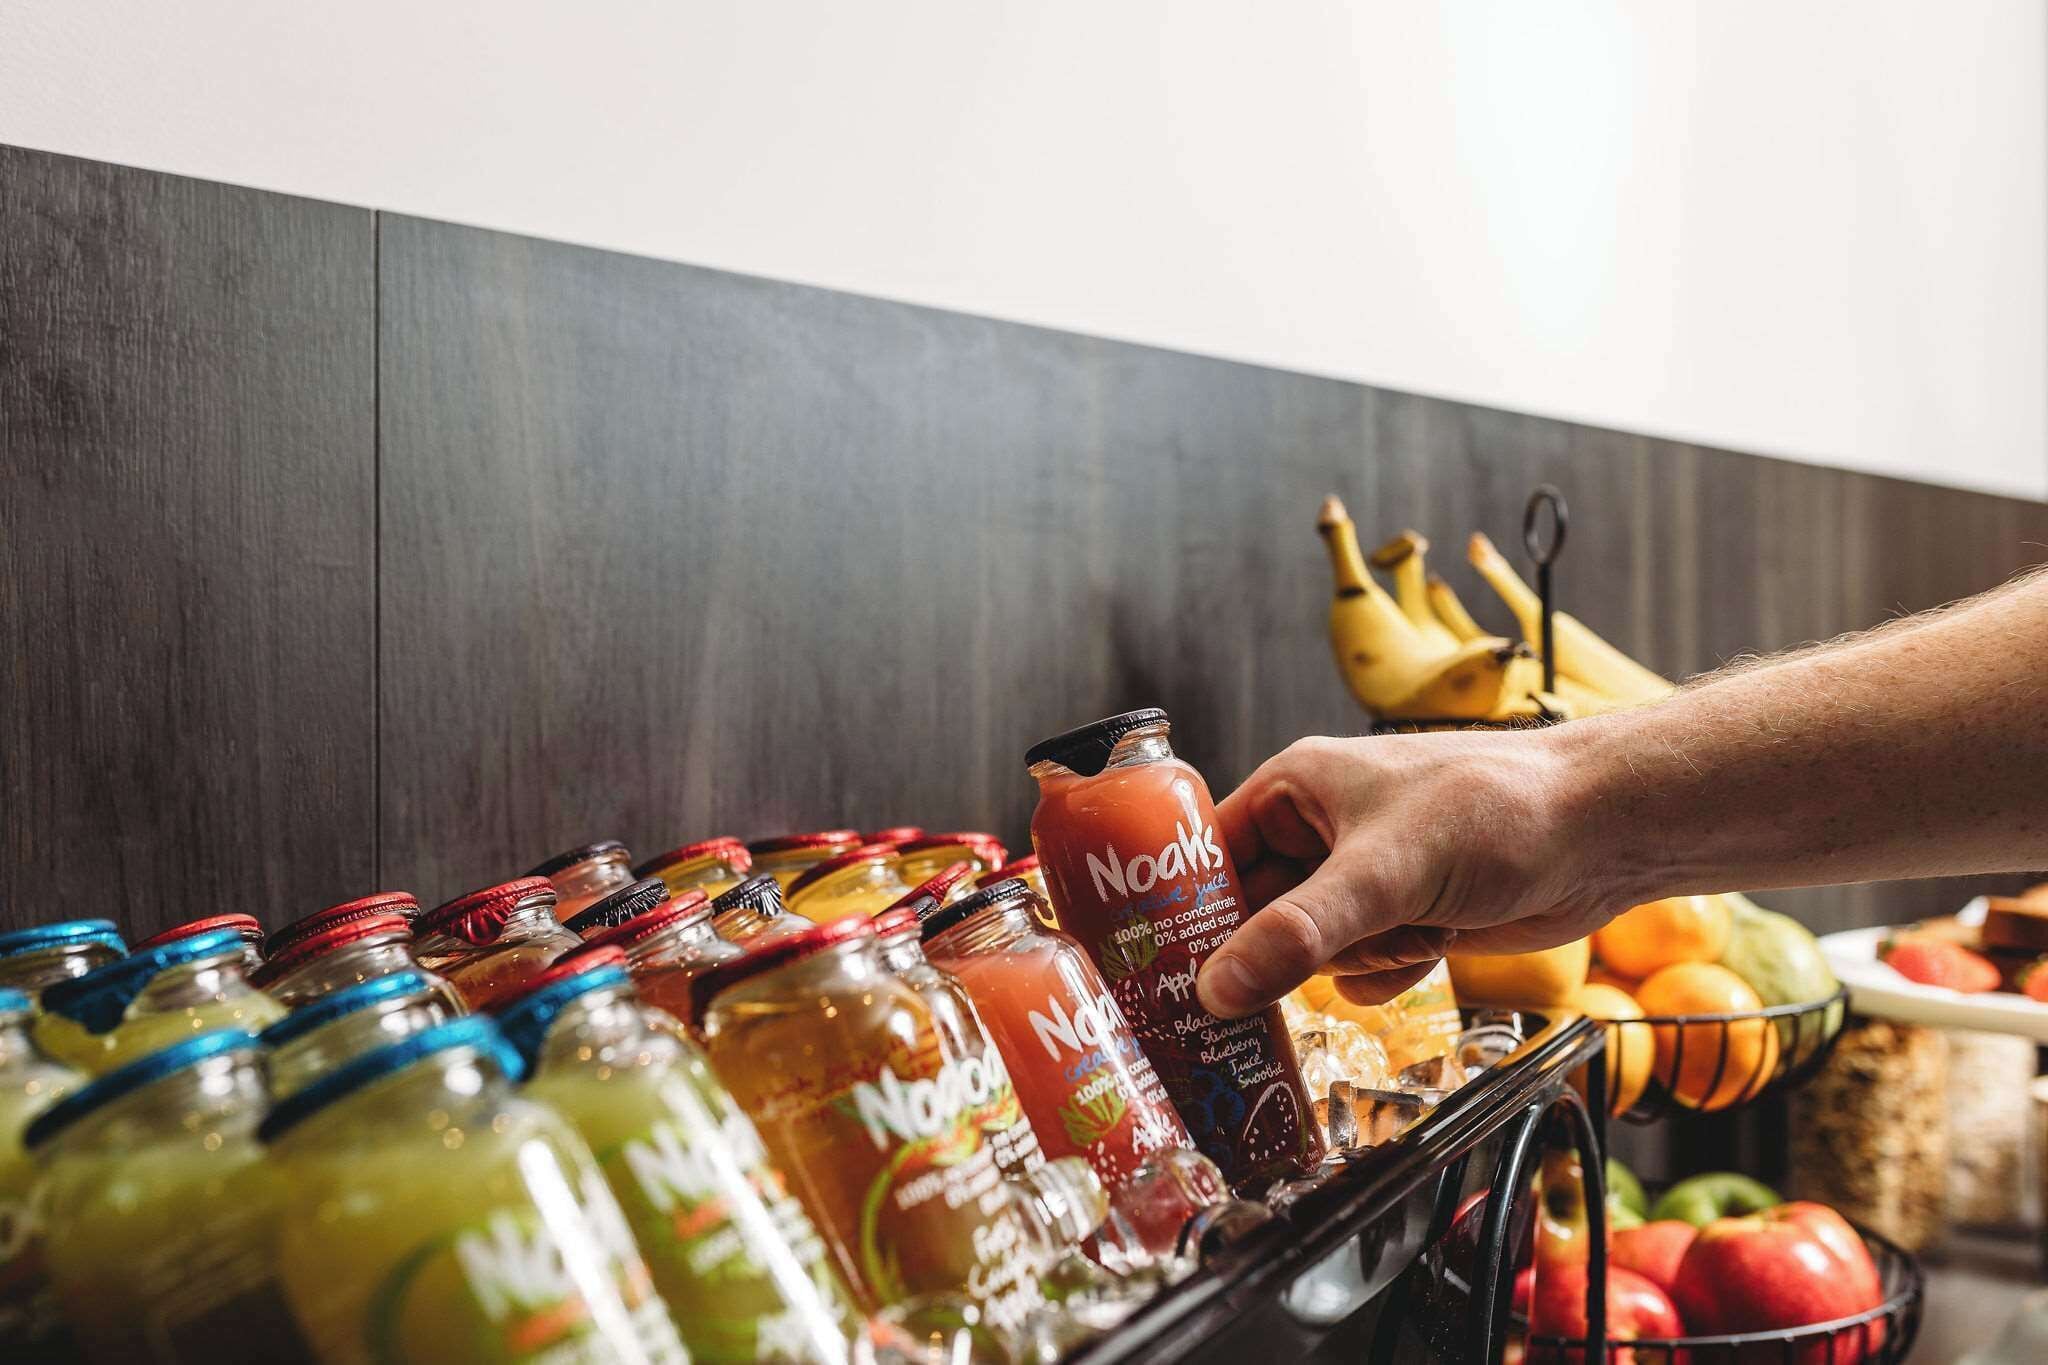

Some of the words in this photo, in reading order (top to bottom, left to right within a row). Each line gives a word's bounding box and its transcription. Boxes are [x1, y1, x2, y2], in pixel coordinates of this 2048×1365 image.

[1114, 921, 1152, 945] 100%
[1154, 917, 1173, 932] no
[1175, 895, 1237, 925] concentrate
[1154, 929, 1177, 947] 0%
[1178, 920, 1217, 940] added
[1218, 909, 1240, 926] sugar
[1188, 939, 1209, 954] 0%
[1157, 957, 1197, 1002] Appl
[1200, 1016, 1268, 1045] Strawberry
[1200, 1037, 1262, 1064] Blueberry
[1229, 1054, 1264, 1076] Juice
[1237, 1061, 1285, 1089] Smoothie
